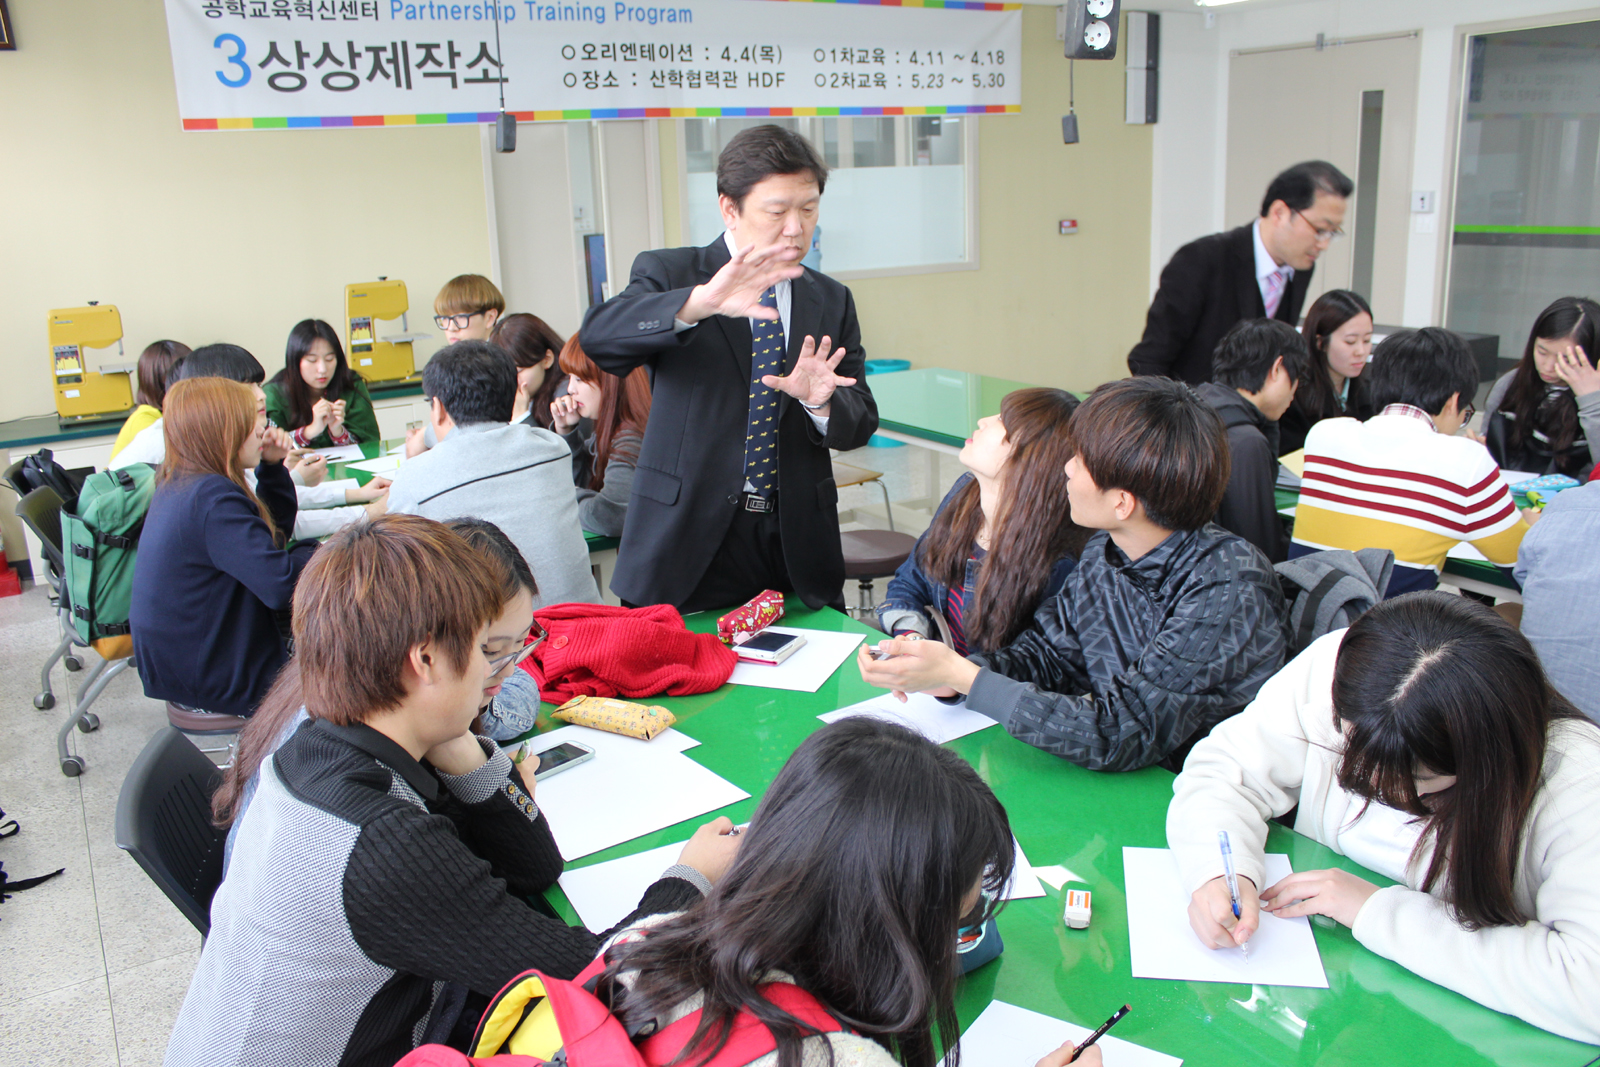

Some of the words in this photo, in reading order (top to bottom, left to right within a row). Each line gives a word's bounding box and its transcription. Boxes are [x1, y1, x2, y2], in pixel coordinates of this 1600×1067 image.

[202, 0, 379, 21] 공학교육혁신센터
[390, 0, 515, 22] Partnership
[524, 1, 606, 24] Training
[614, 2, 693, 25] Program
[581, 42, 693, 62] 오리엔테이션
[720, 44, 783, 64] 4.4(목)
[909, 50, 944, 66] 4.11
[970, 50, 1005, 66] 4.18
[582, 70, 620, 90] 장소
[649, 69, 738, 89] 산학협력관
[747, 72, 786, 88] HDF
[911, 73, 945, 89] 5.23
[972, 73, 1005, 89] 5.30
